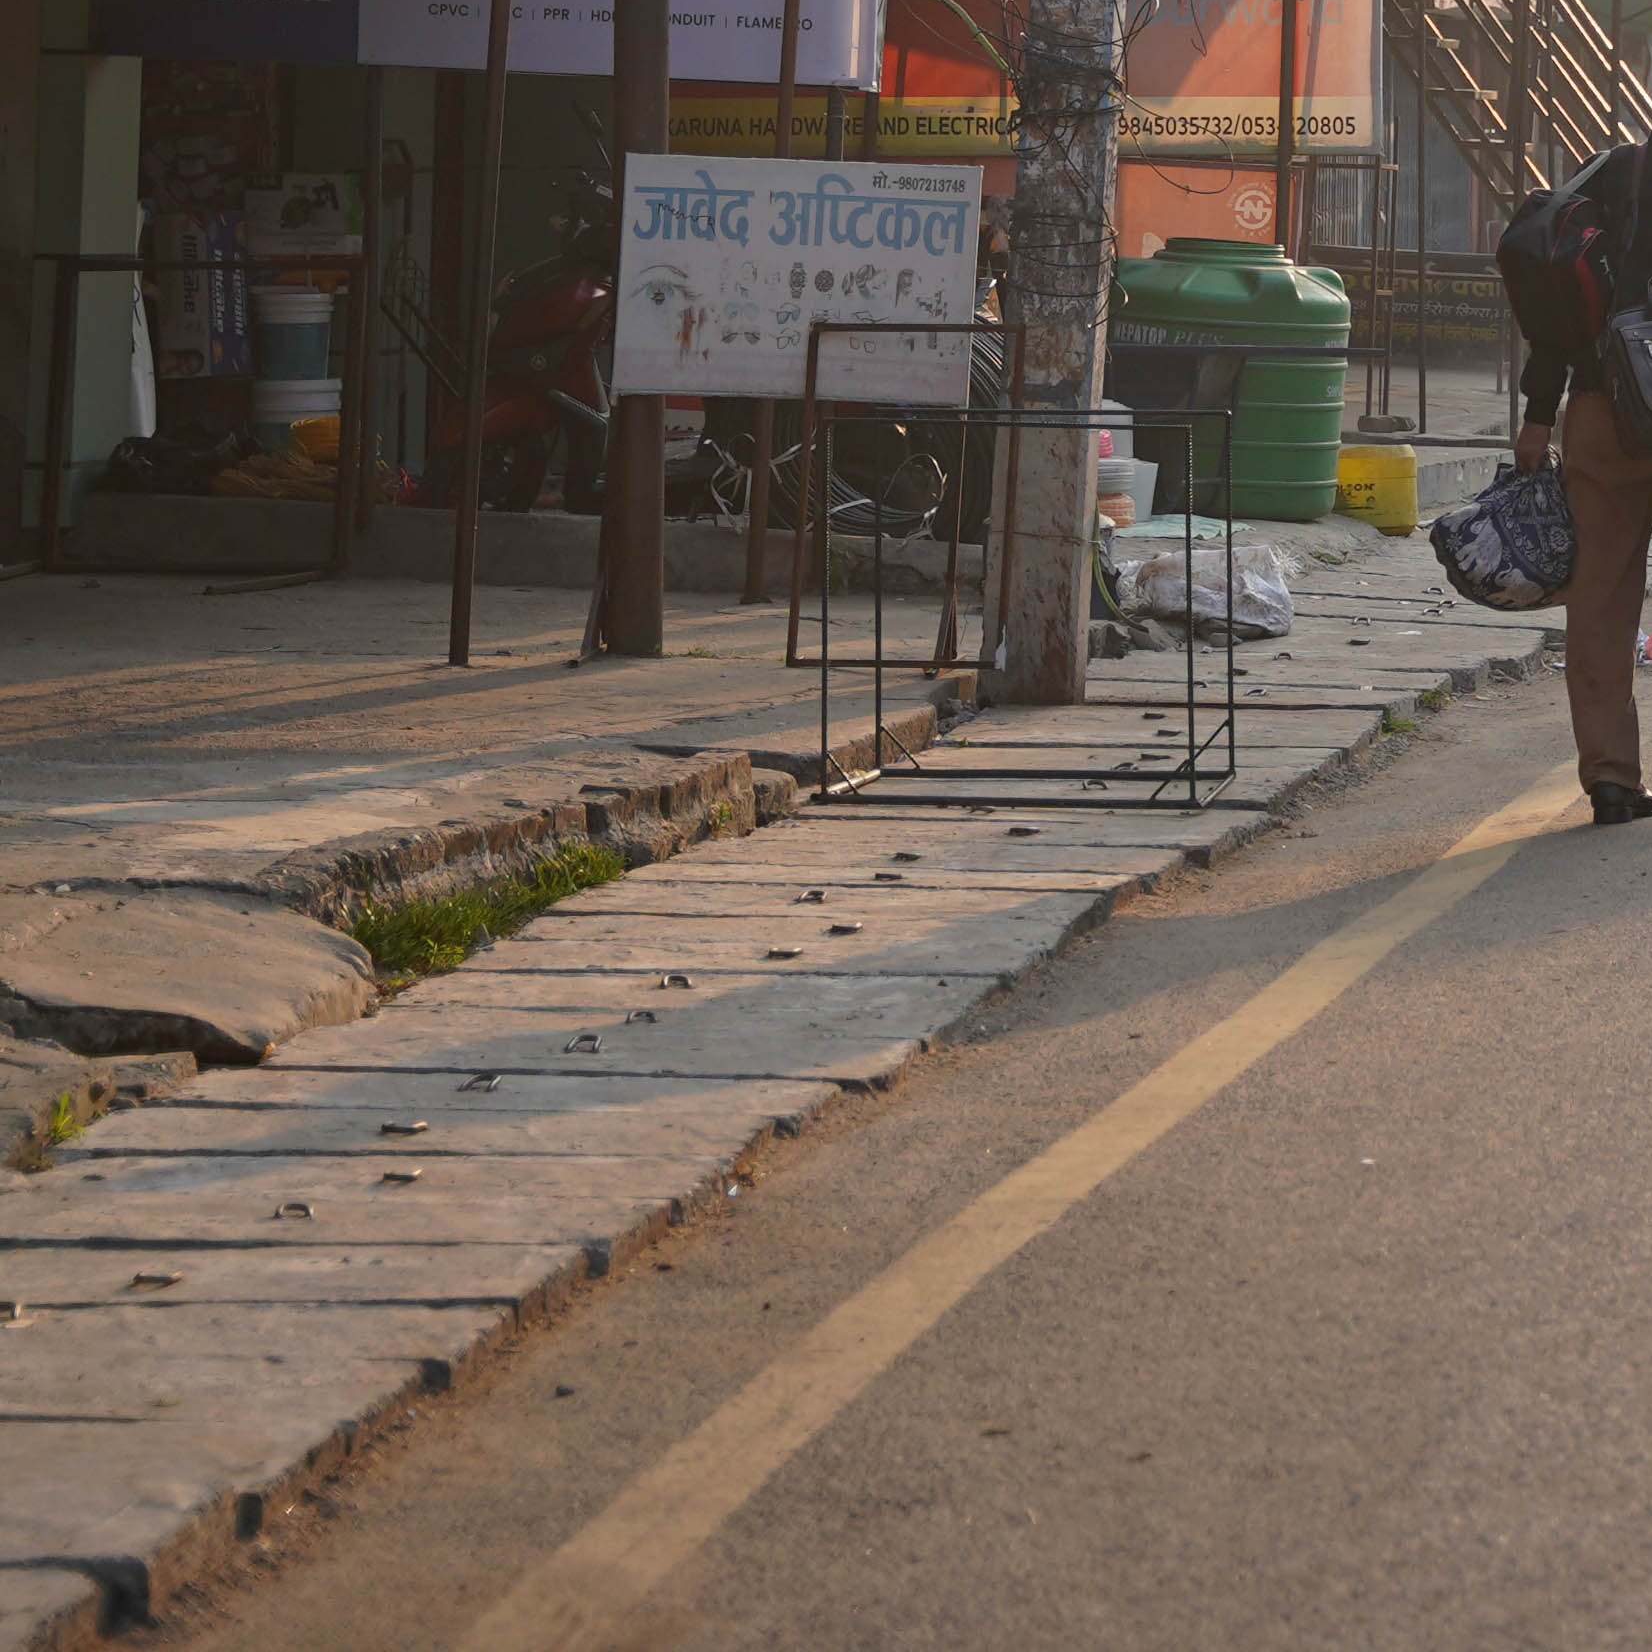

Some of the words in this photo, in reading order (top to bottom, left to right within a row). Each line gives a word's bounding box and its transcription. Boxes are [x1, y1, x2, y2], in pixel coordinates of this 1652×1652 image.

[428, 2, 470, 17] CPVC
[543, 7, 570, 21] PPR
[736, 15, 813, 31] FLAMEO
[1118, 114, 1356, 136] 9845035732/053-20805
[632, 169, 755, 248] जावेद
[768, 173, 971, 257] अप्टिकल
